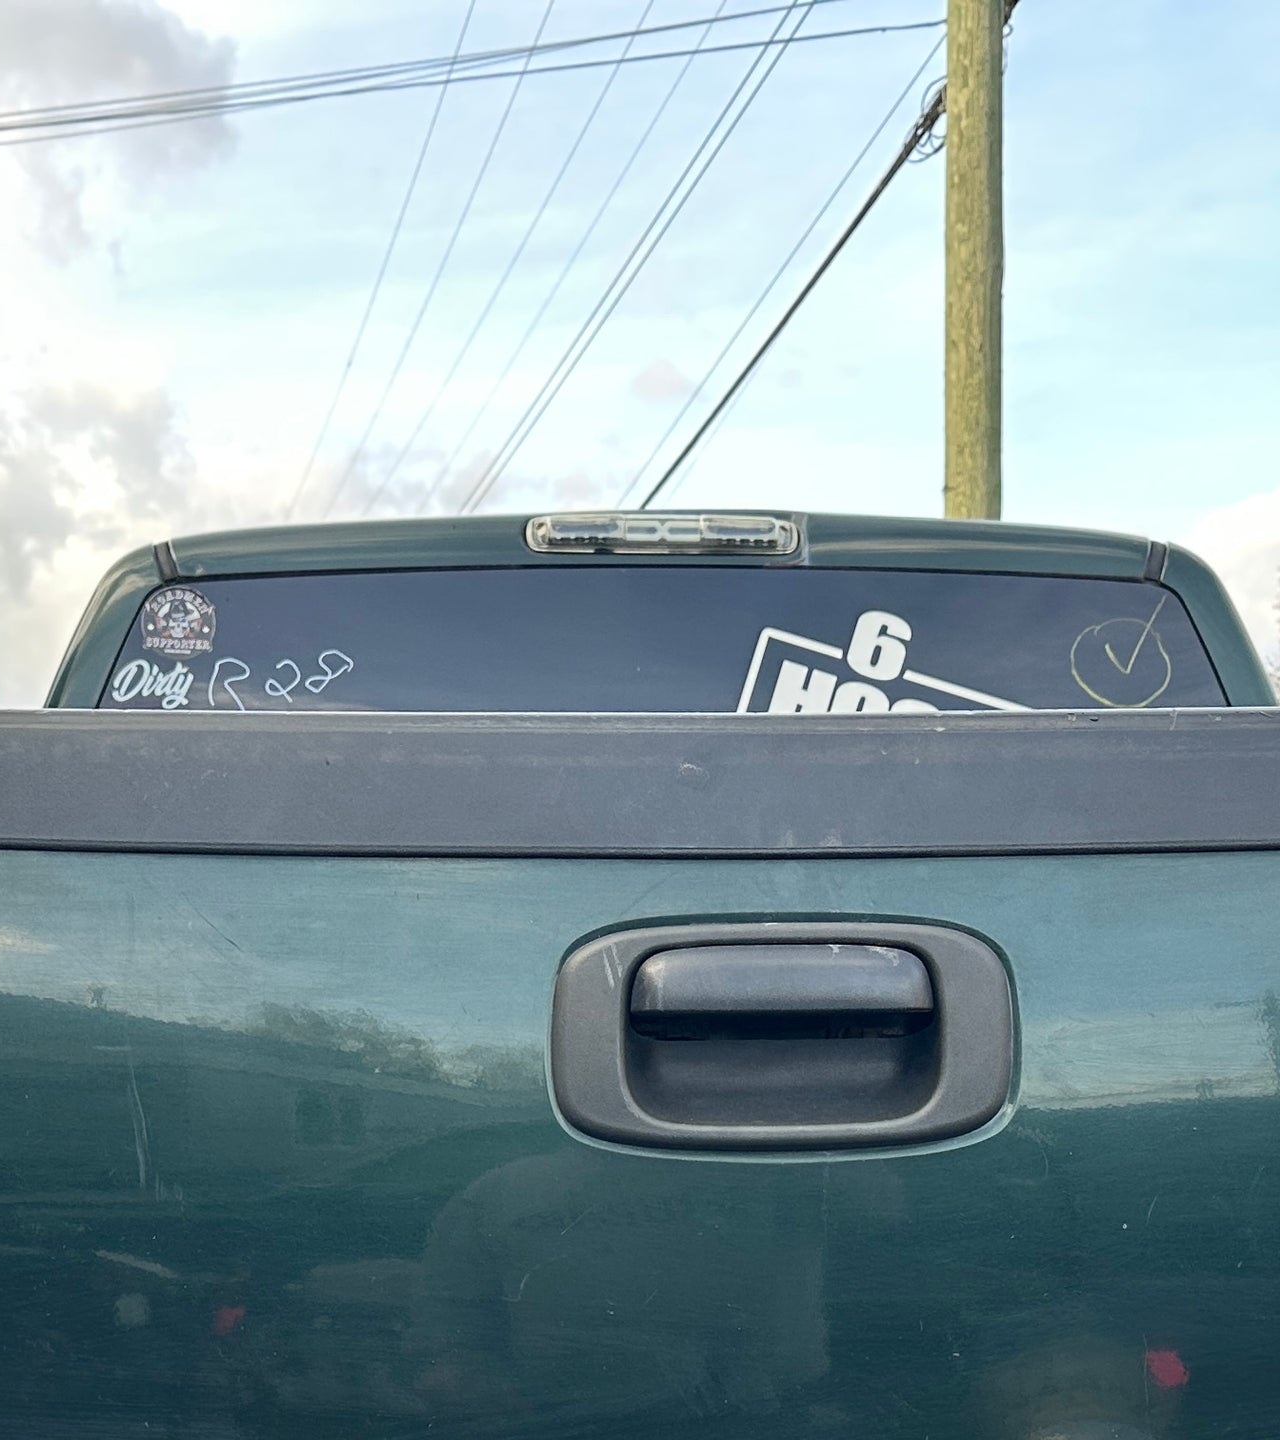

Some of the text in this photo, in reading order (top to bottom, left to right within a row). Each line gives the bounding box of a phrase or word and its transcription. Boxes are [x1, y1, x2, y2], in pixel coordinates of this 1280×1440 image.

[145, 636, 211, 650] SUPPORTER
[846, 610, 912, 681] 6
[112, 659, 194, 710] Dirty
[208, 657, 251, 711] R
